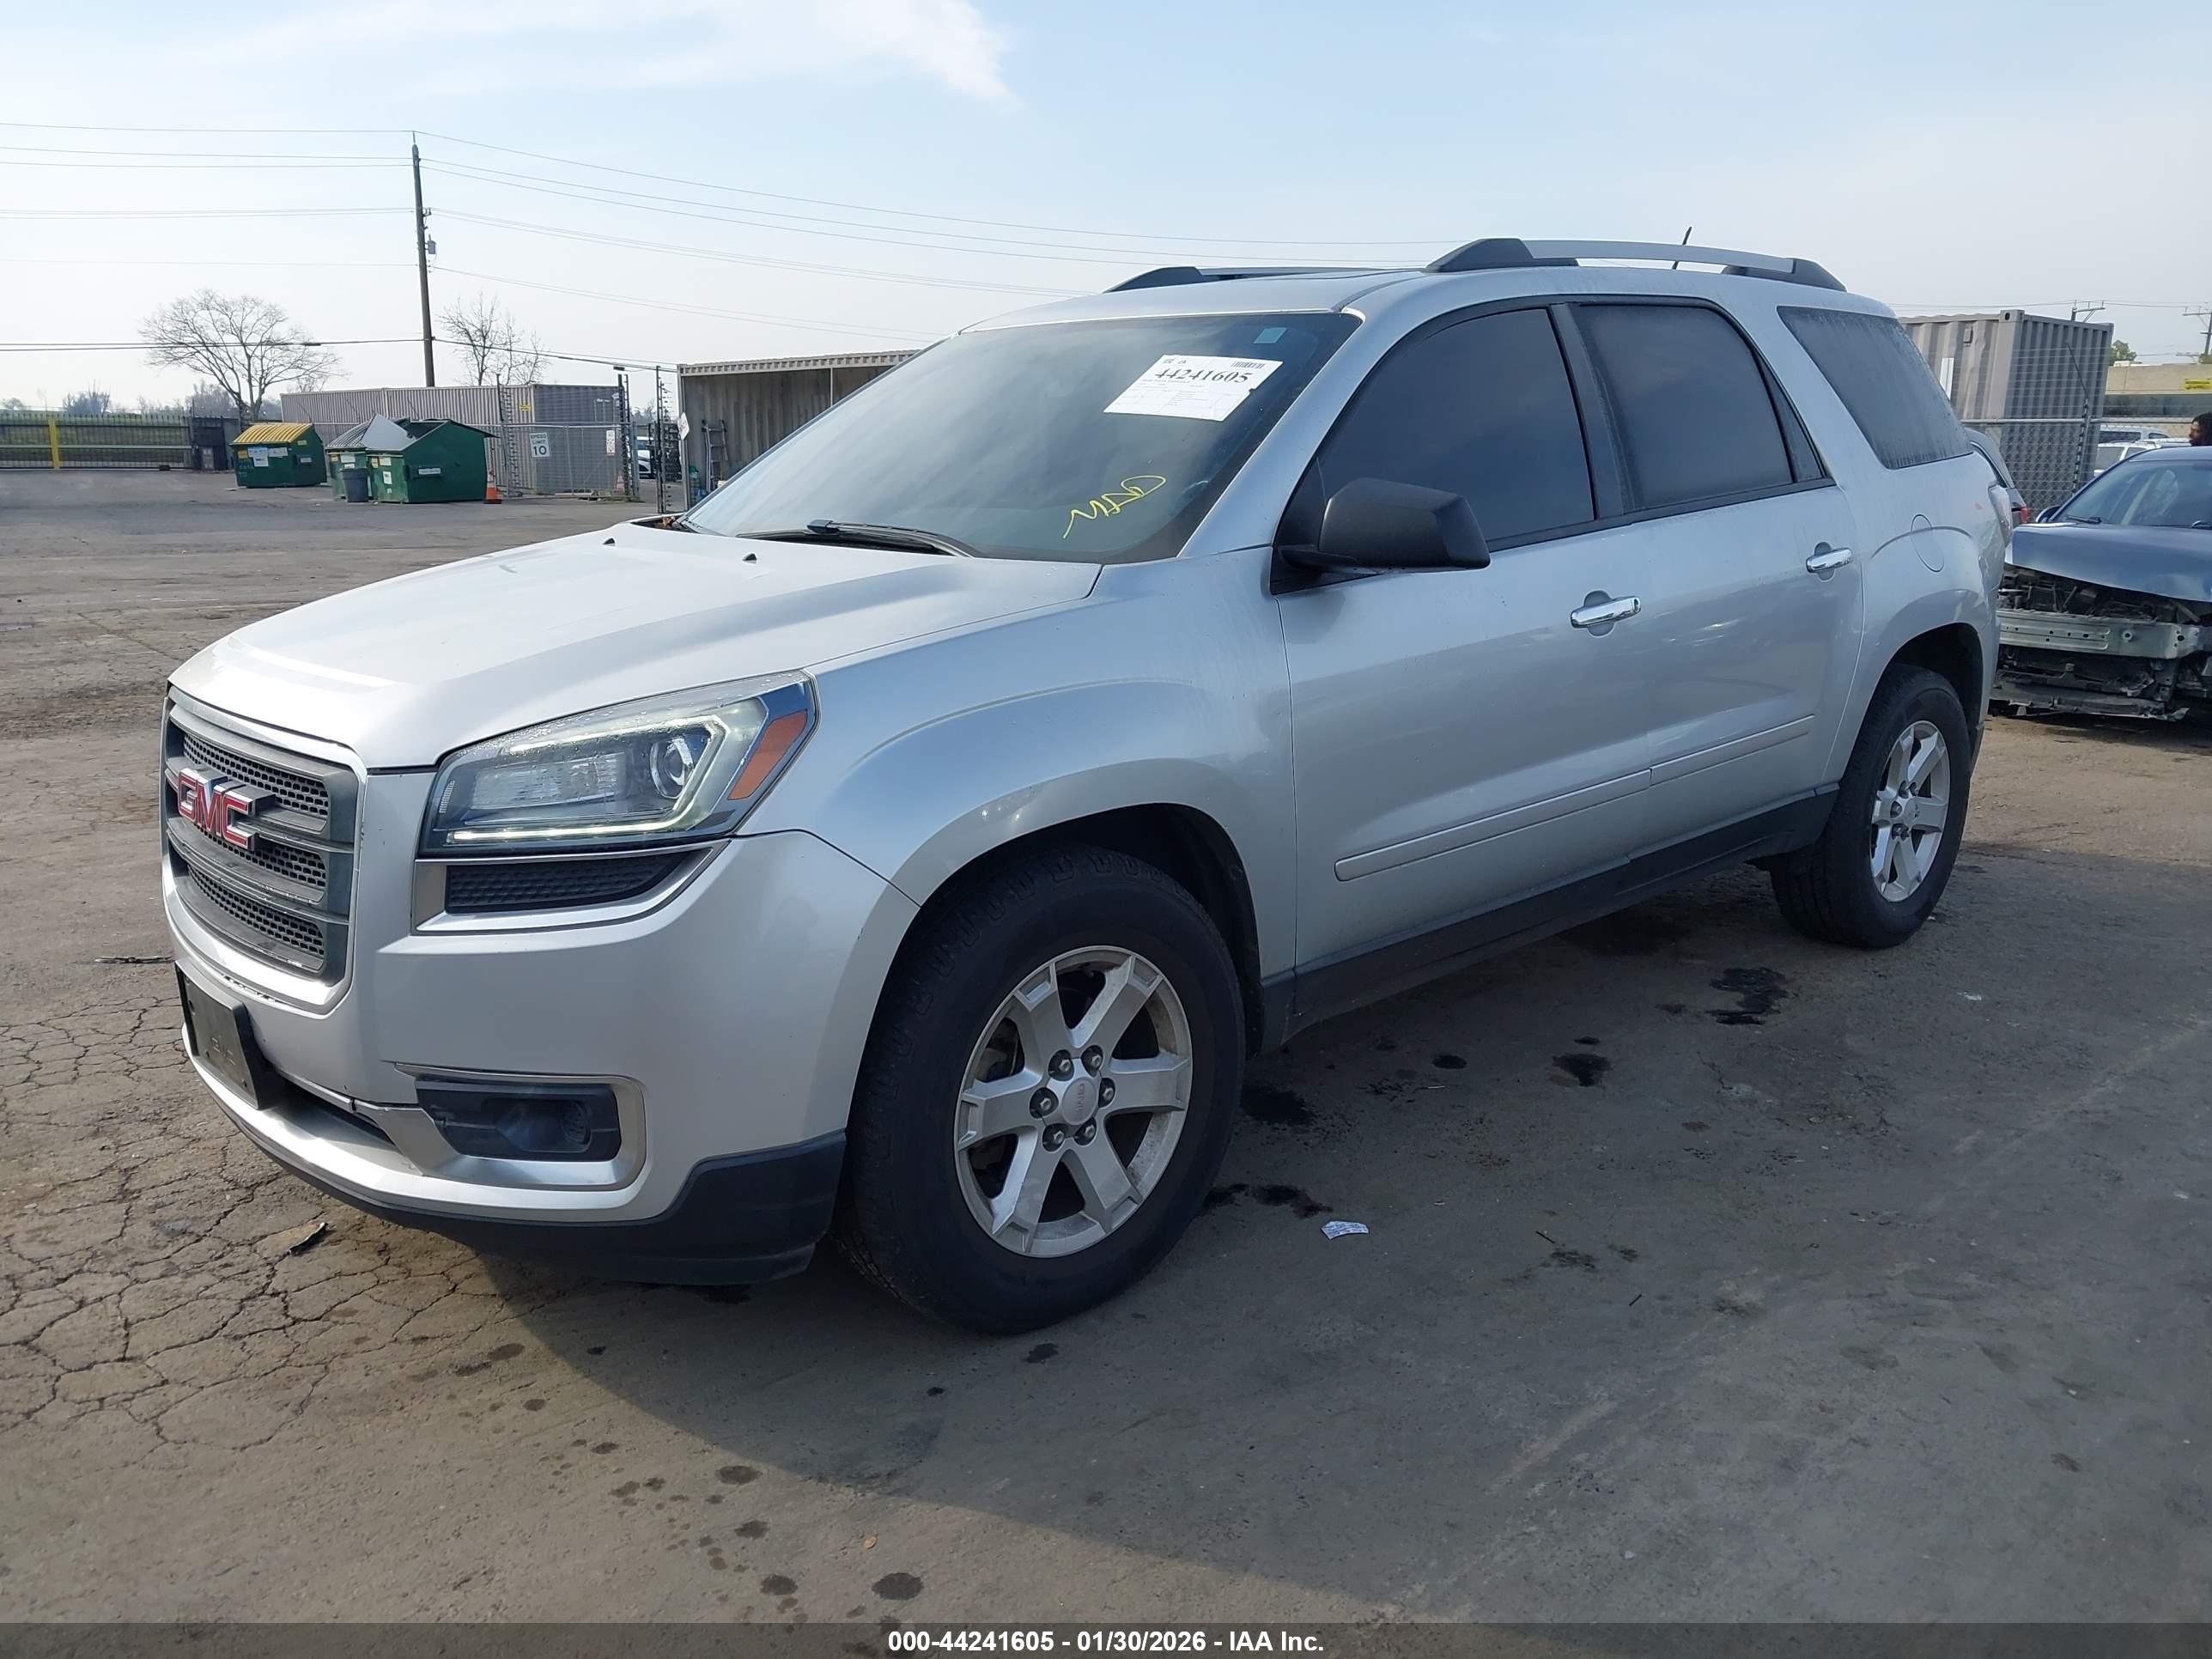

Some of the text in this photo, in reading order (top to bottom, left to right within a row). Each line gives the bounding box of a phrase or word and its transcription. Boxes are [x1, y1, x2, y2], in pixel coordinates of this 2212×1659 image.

[1154, 368, 1253, 383] 44241605
[533, 445, 547, 456] 10
[177, 769, 256, 851] GMC
